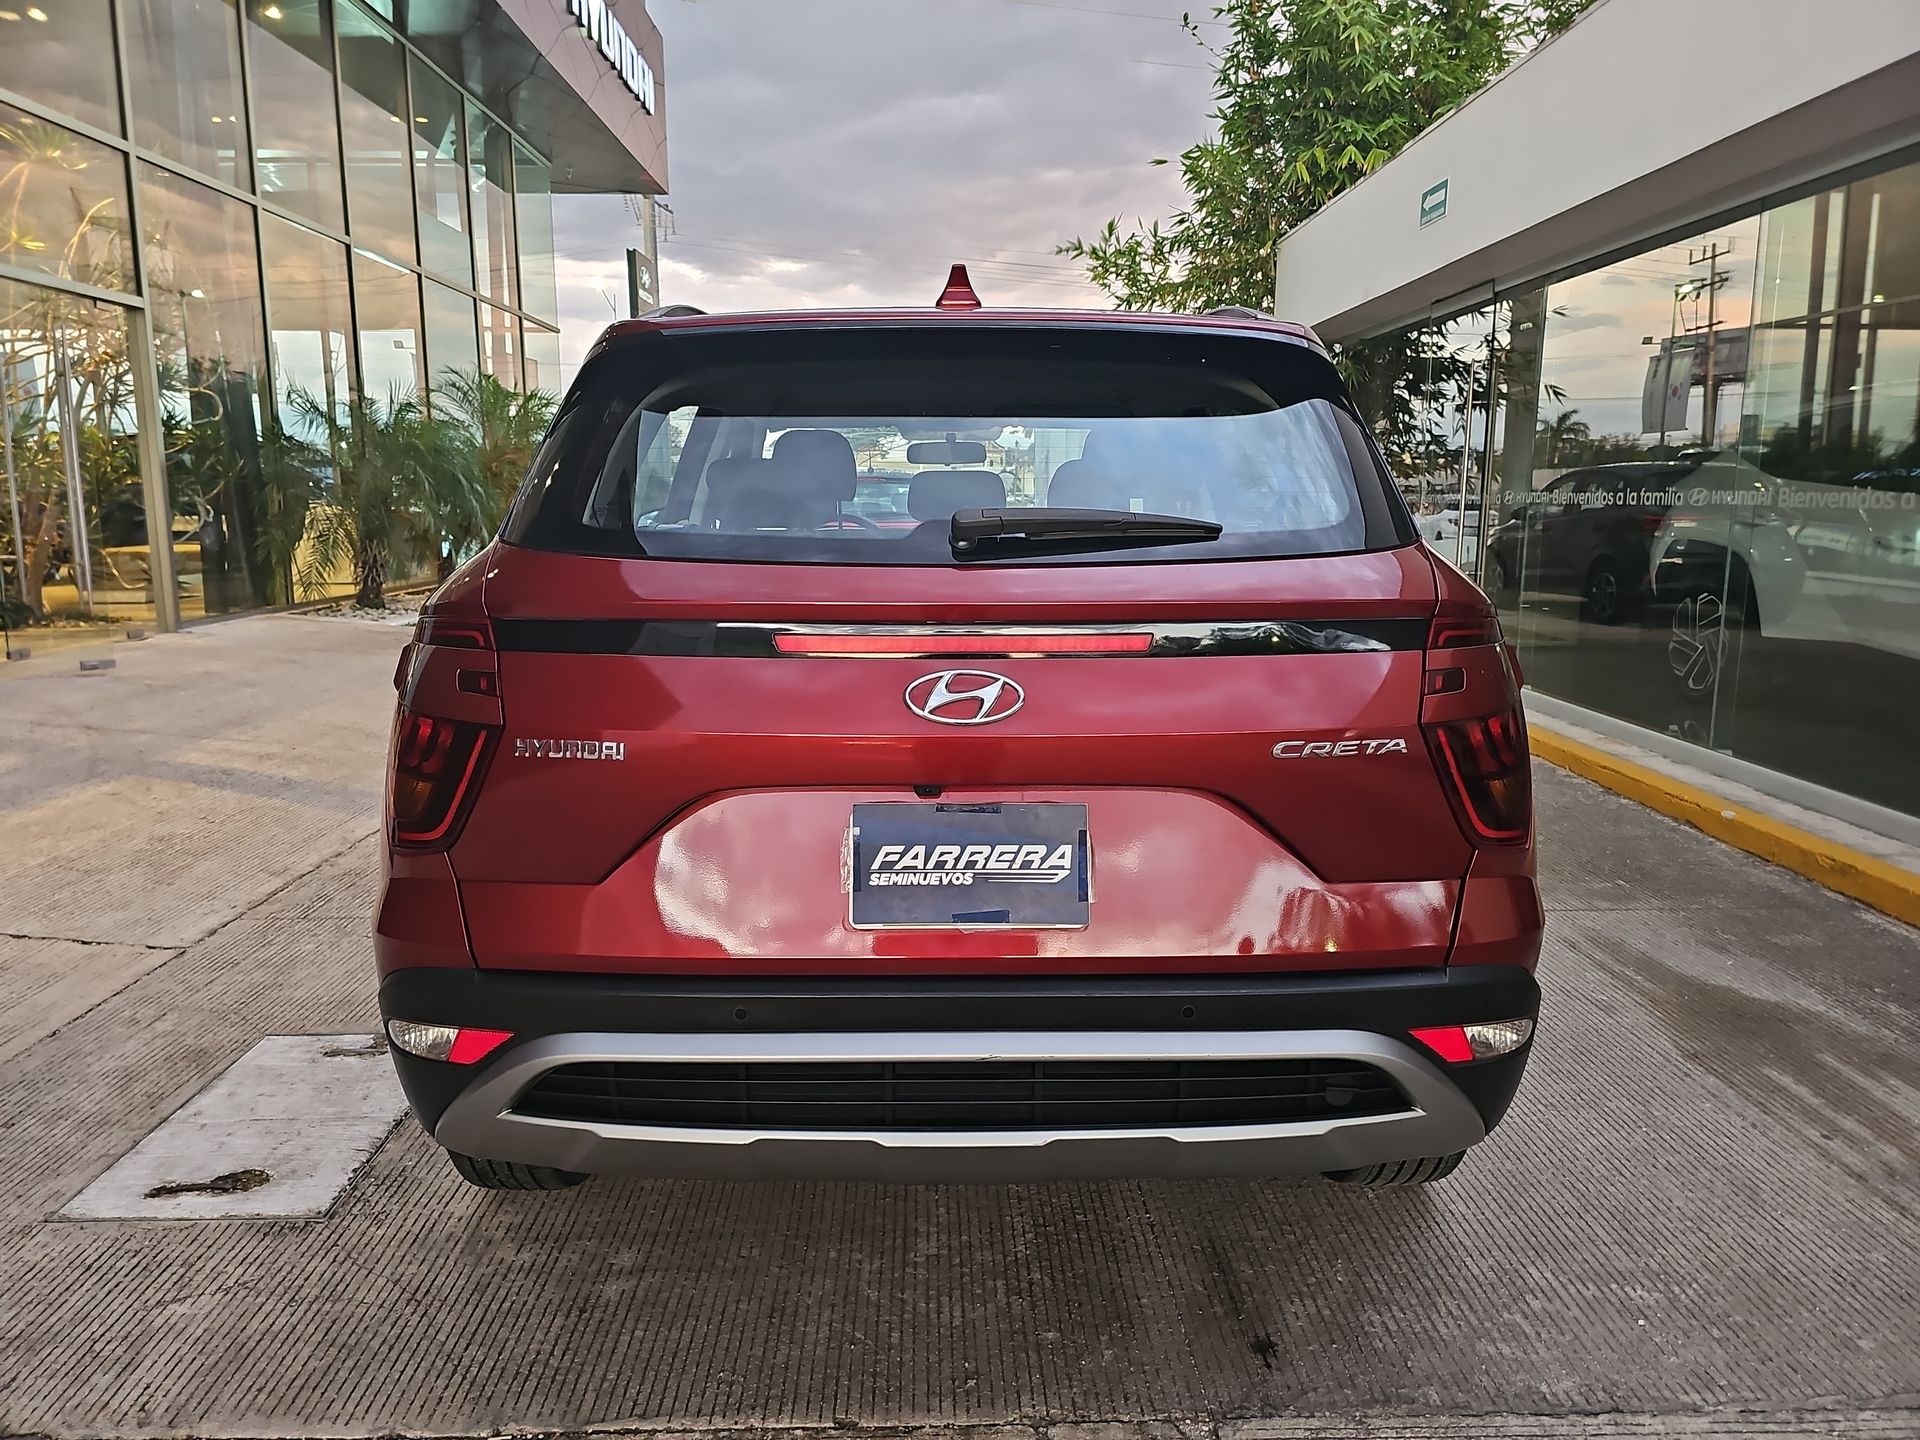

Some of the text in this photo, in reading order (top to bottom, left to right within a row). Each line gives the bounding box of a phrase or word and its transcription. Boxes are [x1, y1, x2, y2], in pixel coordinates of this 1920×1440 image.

[1516, 491, 1549, 503] HYUNDAI
[1552, 487, 1771, 506] Bienvenidos a la familia HYUNDAI
[1778, 485, 1916, 510] Bienvenidos a
[515, 739, 625, 761] HYUNDAI
[1272, 738, 1408, 759] CRETA
[870, 844, 1073, 870] FARRERA
[869, 872, 974, 886] SEMINUEVOS
